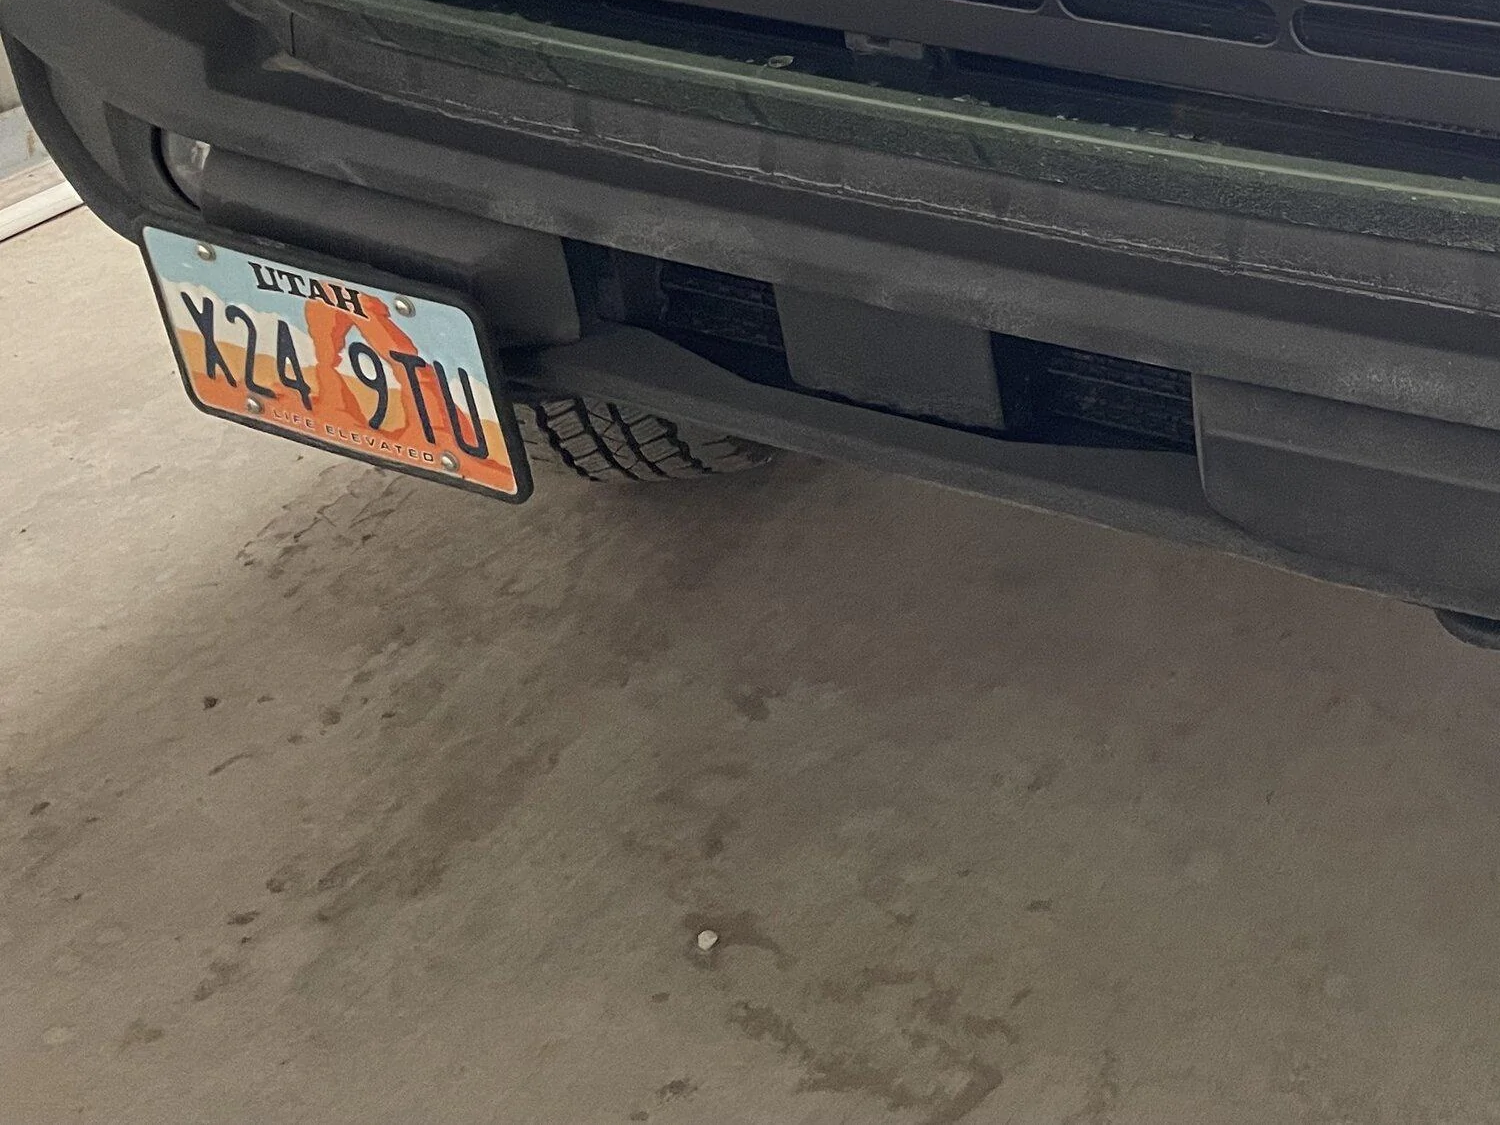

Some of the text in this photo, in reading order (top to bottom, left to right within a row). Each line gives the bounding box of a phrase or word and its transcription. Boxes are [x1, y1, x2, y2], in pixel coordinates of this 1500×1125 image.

[248, 261, 369, 319] UTAH
[272, 408, 435, 463] LIFE ELEVATED
